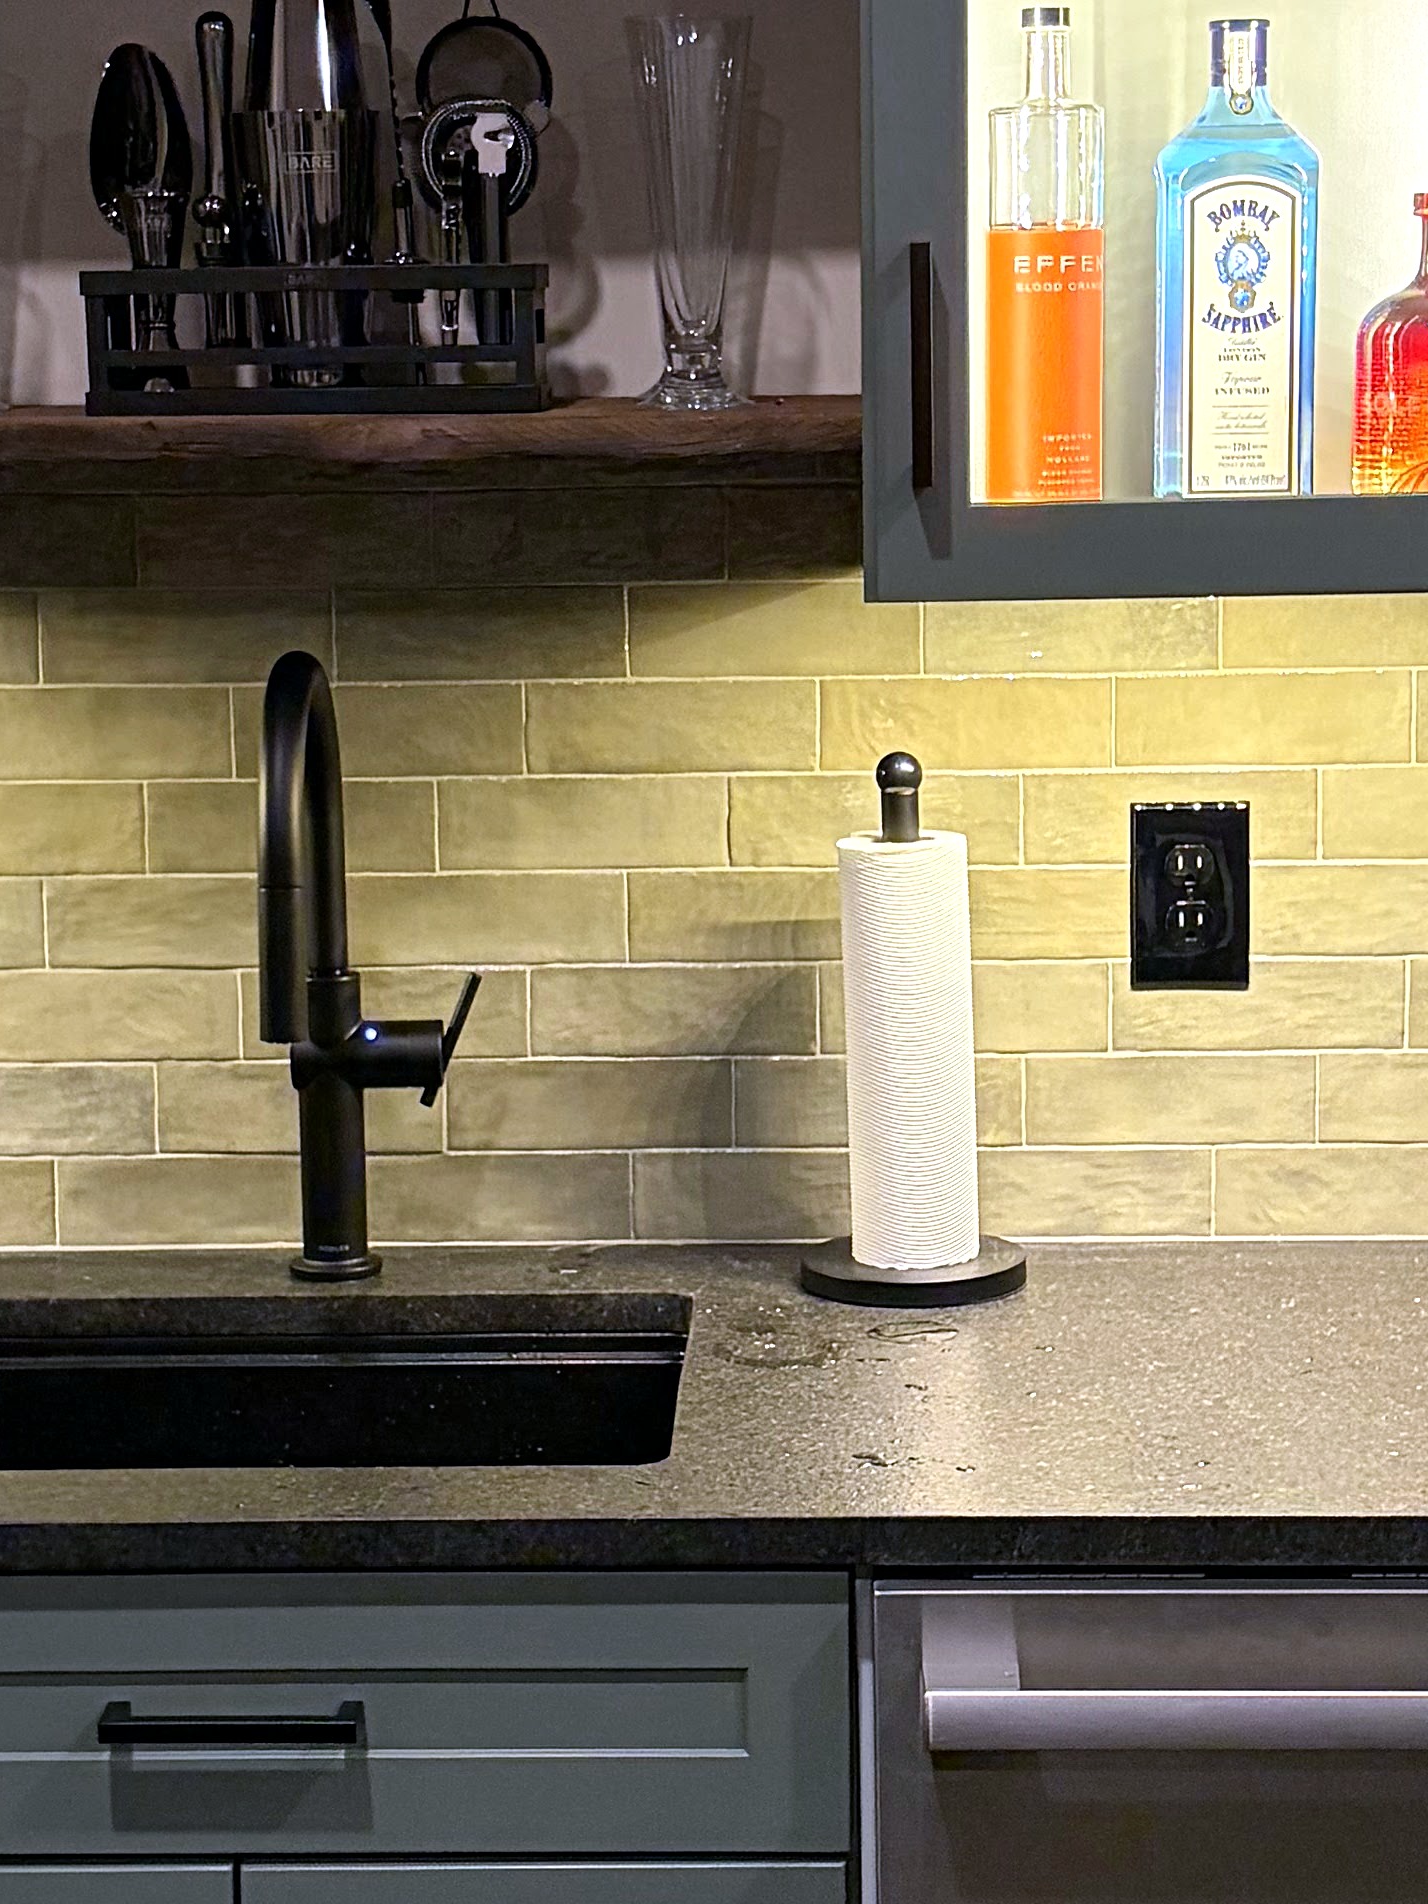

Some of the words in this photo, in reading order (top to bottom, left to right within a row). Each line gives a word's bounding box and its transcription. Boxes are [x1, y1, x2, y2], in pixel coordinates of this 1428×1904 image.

[287, 155, 333, 169] BARE
[1206, 199, 1281, 232] BOMBAY
[1015, 281, 1063, 293] BLOOD
[1201, 301, 1282, 335] SAPPHIRE
[1244, 353, 1267, 362] GIN
[1215, 387, 1270, 396] INFUSED
